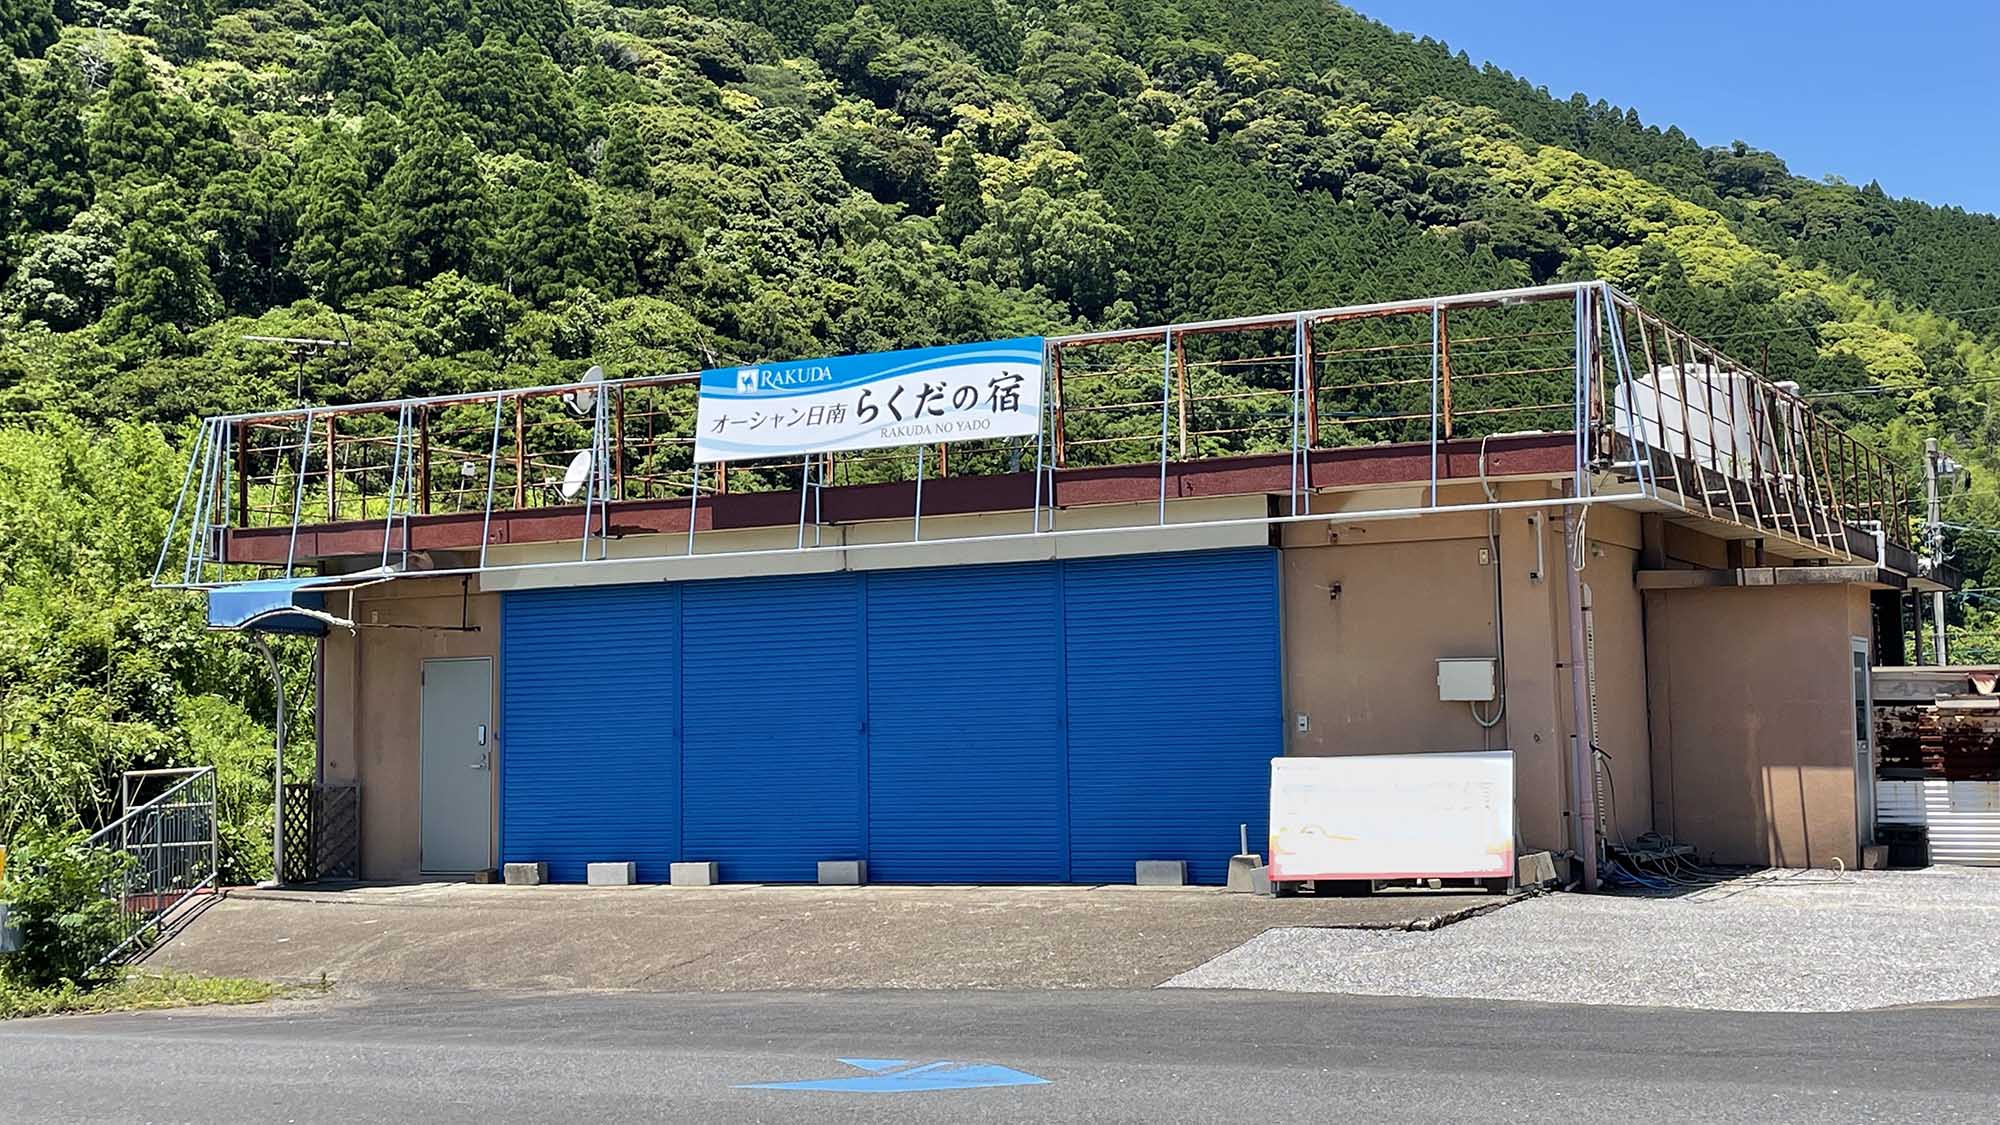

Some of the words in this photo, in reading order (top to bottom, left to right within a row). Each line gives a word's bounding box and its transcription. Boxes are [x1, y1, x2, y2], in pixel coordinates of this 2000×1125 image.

[760, 365, 832, 389] RAKUDA
[711, 402, 846, 434] オーシャン日南
[856, 370, 1025, 425] らくだの宿
[880, 425, 933, 439] RAKUDA
[935, 423, 954, 434] NO
[956, 418, 991, 432] YADO
